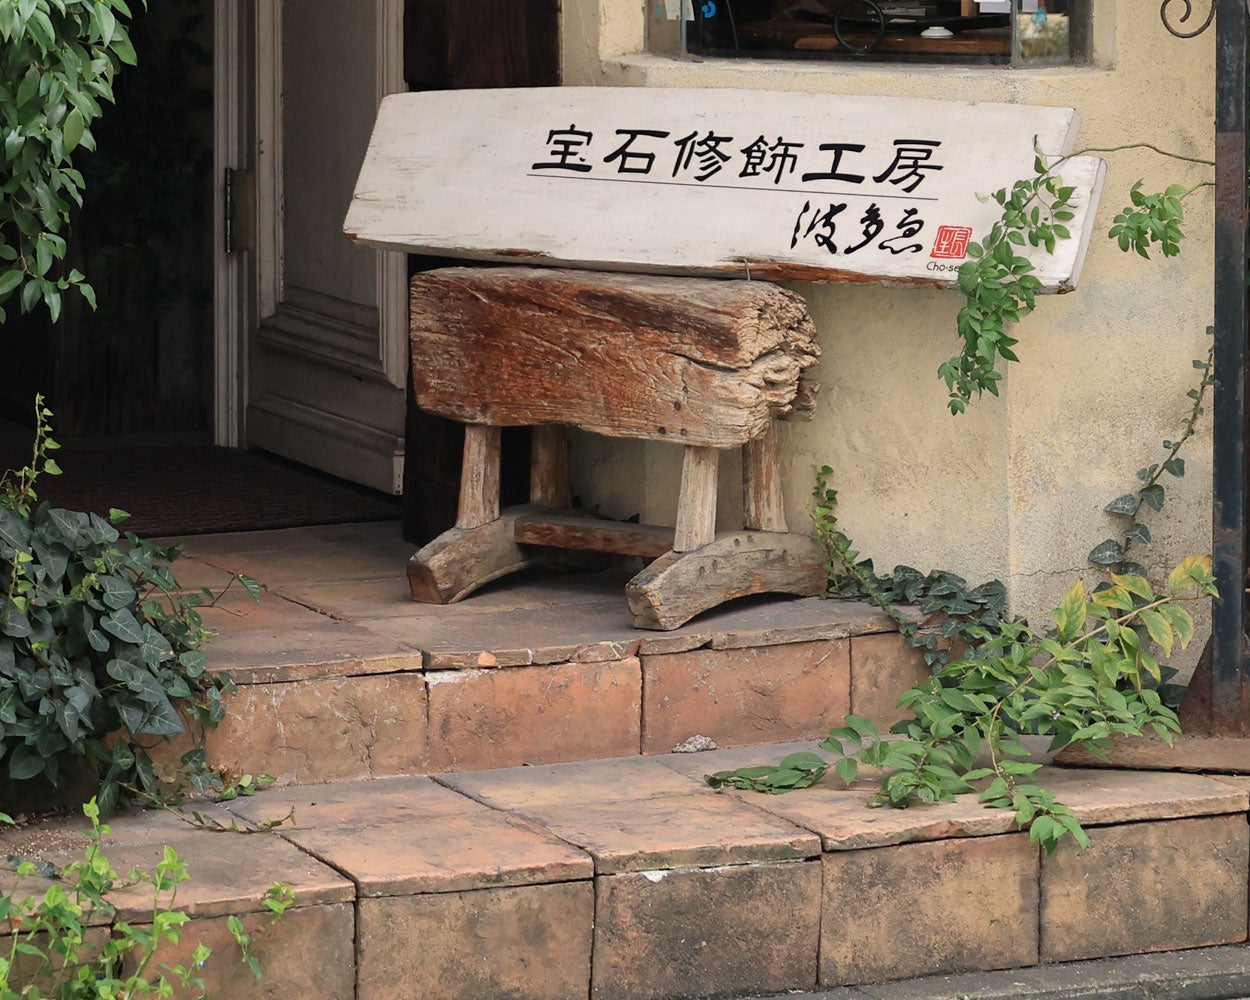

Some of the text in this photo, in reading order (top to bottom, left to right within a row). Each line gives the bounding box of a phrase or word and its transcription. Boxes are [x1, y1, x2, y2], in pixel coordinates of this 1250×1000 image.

[532, 123, 943, 194] 宝石修飾工房
